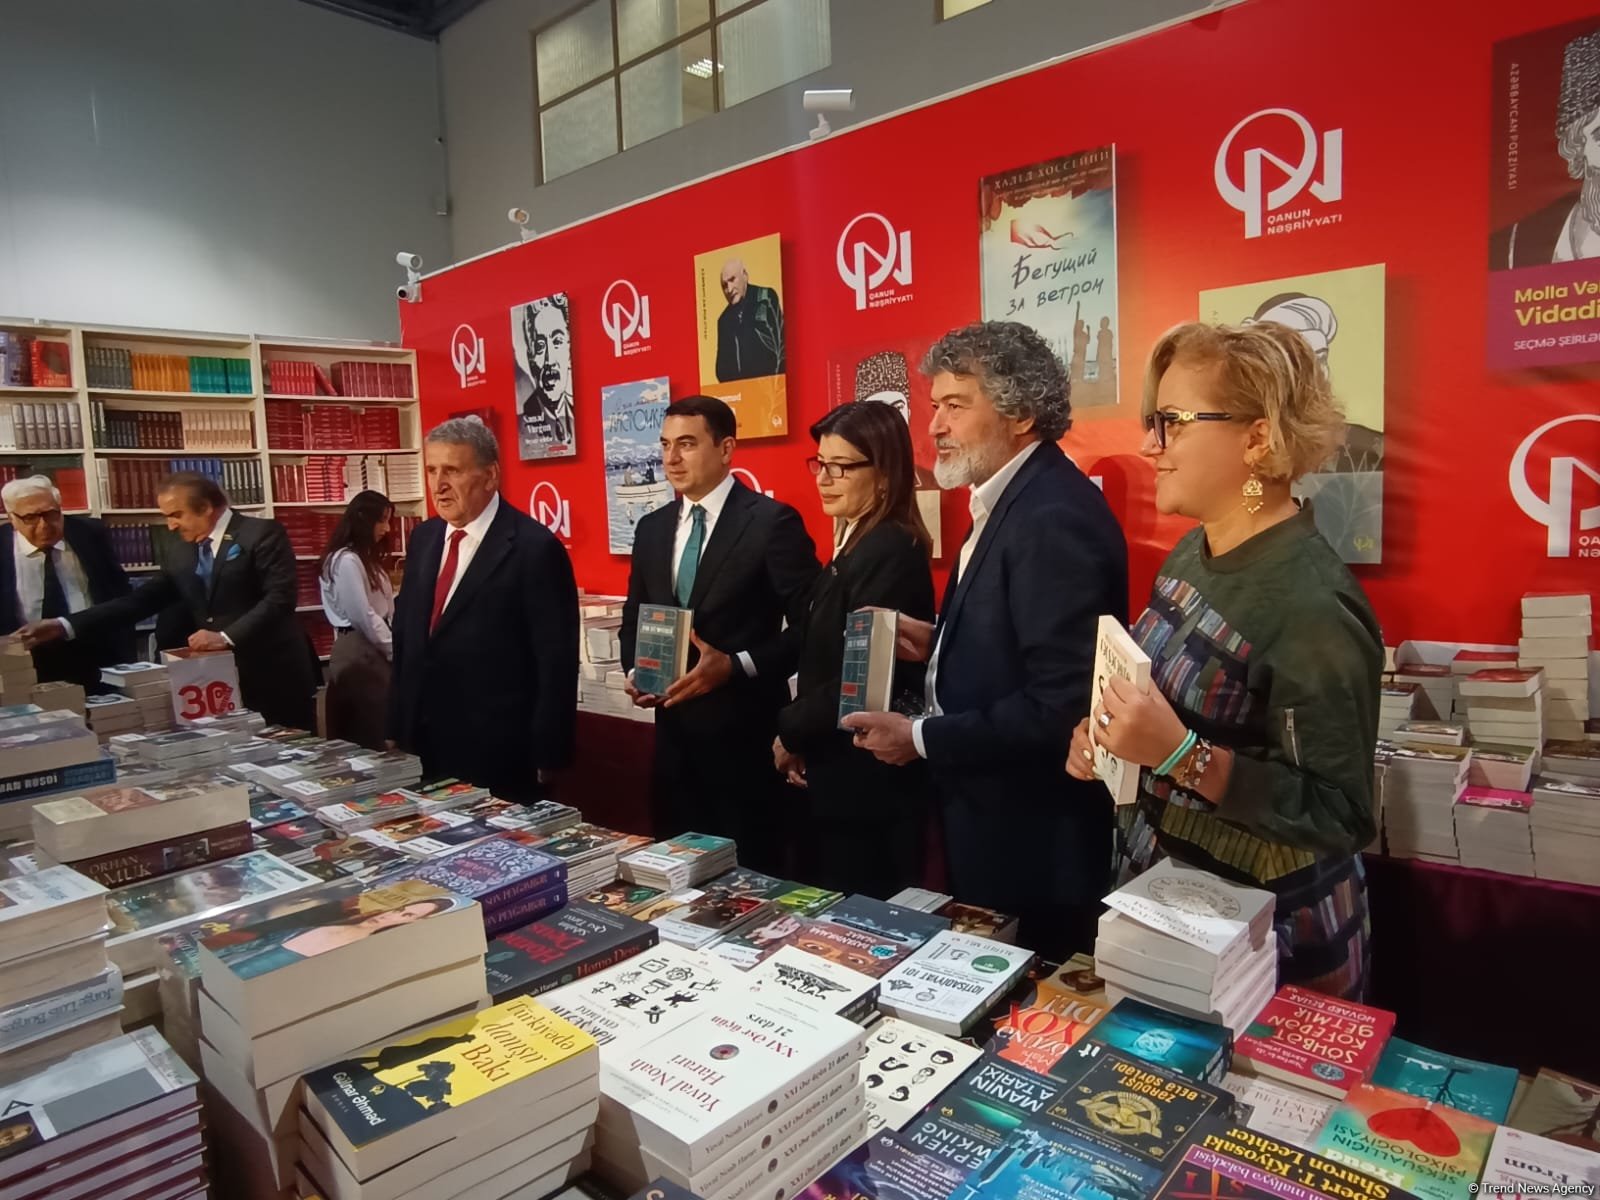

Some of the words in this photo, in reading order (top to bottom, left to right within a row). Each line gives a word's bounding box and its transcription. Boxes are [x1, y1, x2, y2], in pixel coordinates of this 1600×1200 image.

[1509, 63, 1520, 132] AZƏRBAYCAN
[1267, 208, 1310, 224] QANUN
[1267, 214, 1342, 235] NƏŞRİYYATI
[1011, 248, 1097, 290] Бегущий
[869, 289, 894, 300] QANUN
[1514, 285, 1568, 303] Molla
[1573, 281, 1600, 296] Və
[1514, 299, 1600, 326] Vidadi
[1514, 338, 1556, 350] SEÇMƏ
[89, 855, 138, 874] ORHAN
[576, 957, 612, 978] Homo
[902, 966, 916, 978] 101
[918, 970, 985, 996] İQTİSADİYYAT
[506, 1001, 575, 1050] Türkiyədə
[746, 1013, 775, 1034] dərs
[1007, 1001, 1077, 1046] YOX
[1328, 1006, 1376, 1023] HOVARD
[774, 1024, 794, 1038] 21
[1268, 1015, 1368, 1050] KOFEDƏN
[765, 1040, 800, 1058] XXI
[1274, 1028, 1358, 1064] SÖHBƏT
[461, 1044, 510, 1082] Bakı
[630, 1056, 674, 1088] Noah
[671, 1054, 726, 1086] Harari
[1114, 1062, 1164, 1086] SÖYLƏDİ
[332, 1072, 358, 1098] Gülnar
[969, 1074, 1044, 1114] MANIN
[980, 1064, 1038, 1095] TARİXİ
[1118, 1072, 1177, 1104] ZƏRDÜŞT
[1164, 1080, 1198, 1102] BELƏ
[676, 1080, 724, 1112] Yuval
[912, 1134, 982, 1170] EPHEN
[922, 1122, 995, 1160] WKING
[1078, 1150, 1092, 1160] THE
[1202, 1134, 1290, 1176] Kiyosaki
[1226, 1126, 1306, 1163] Lechter
[1333, 1123, 1467, 1178] PSİXOLOGİYASI
[1094, 1158, 1107, 1168] OF
[1194, 1149, 1247, 1178] bələdçisi
[1332, 1134, 1458, 1184] SEKSUALLIĞIN
[1503, 1156, 1570, 1184] From
[1246, 1168, 1300, 1197] maliyyə
[1292, 1166, 1314, 1186] T.
[1308, 1156, 1390, 1198] Sharon
